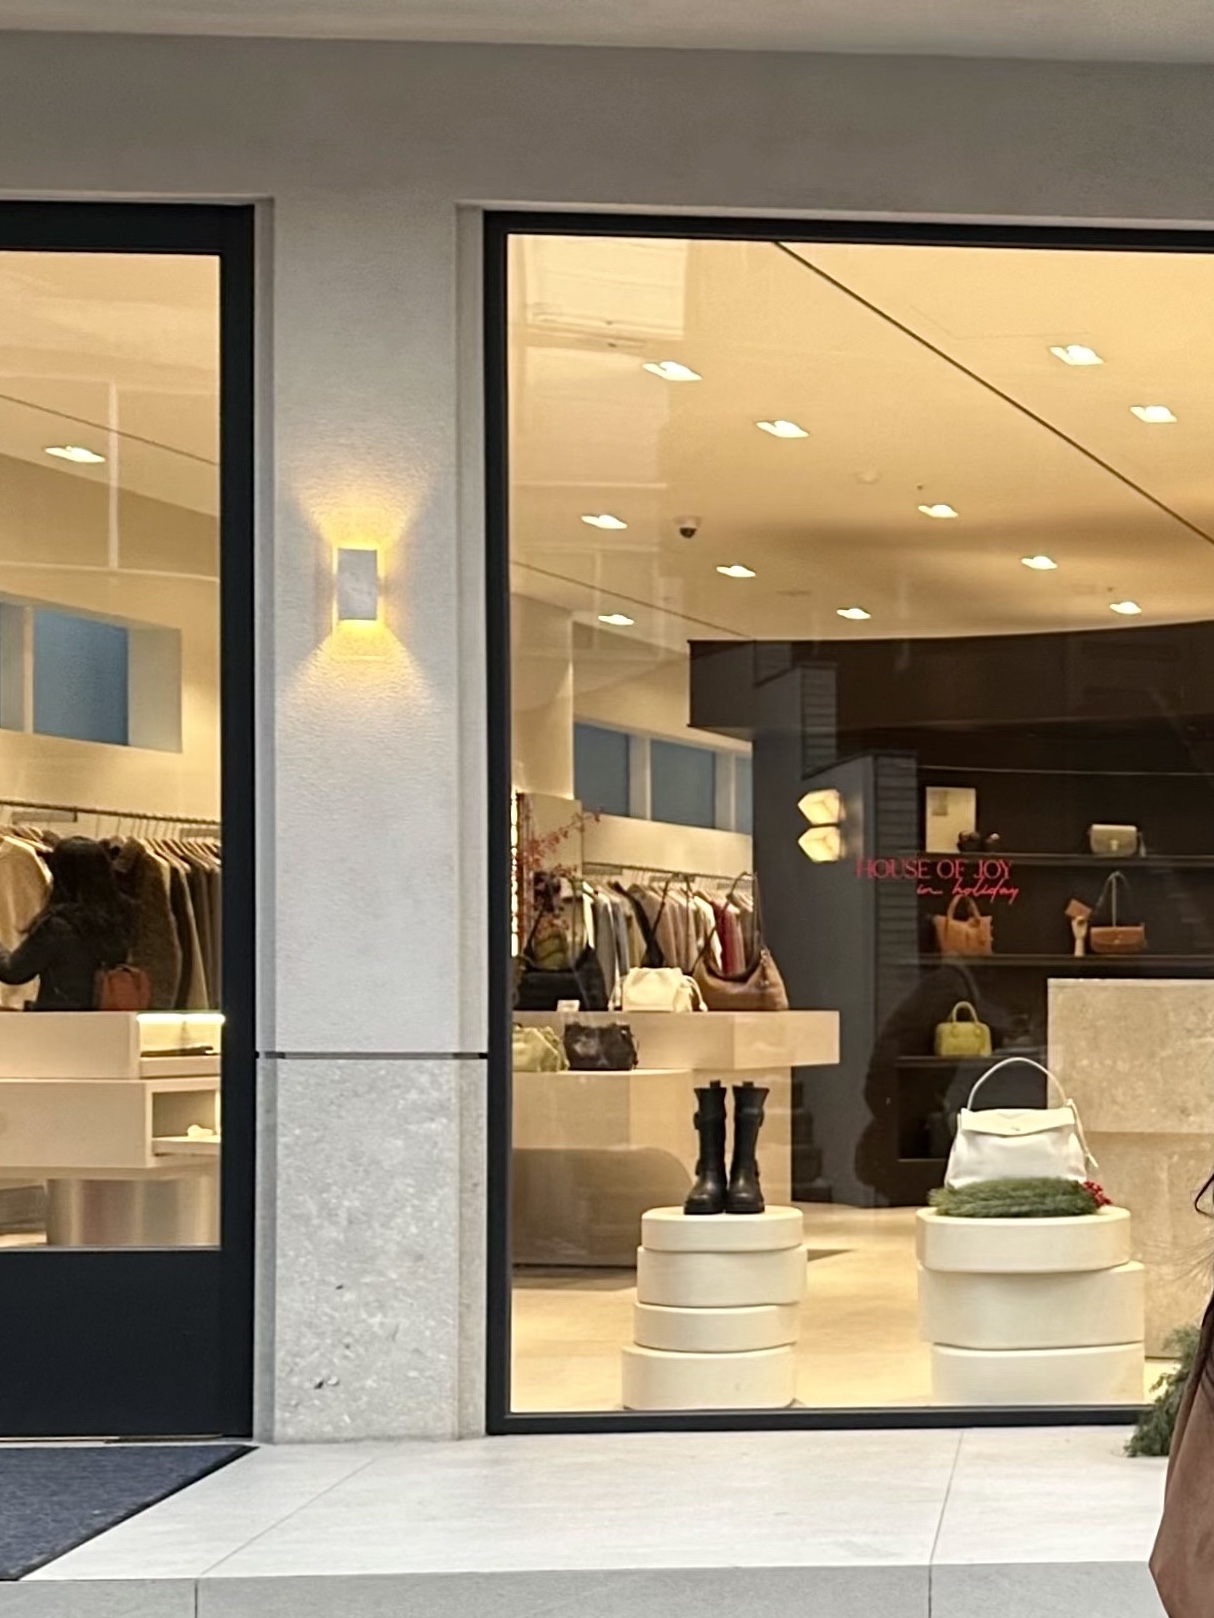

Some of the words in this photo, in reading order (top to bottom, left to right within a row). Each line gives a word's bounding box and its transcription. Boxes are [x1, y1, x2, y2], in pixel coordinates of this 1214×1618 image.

[856, 859, 932, 880] HOUSE
[936, 859, 967, 879] OF
[973, 859, 1013, 880] JOY
[952, 877, 1019, 905] holiday
